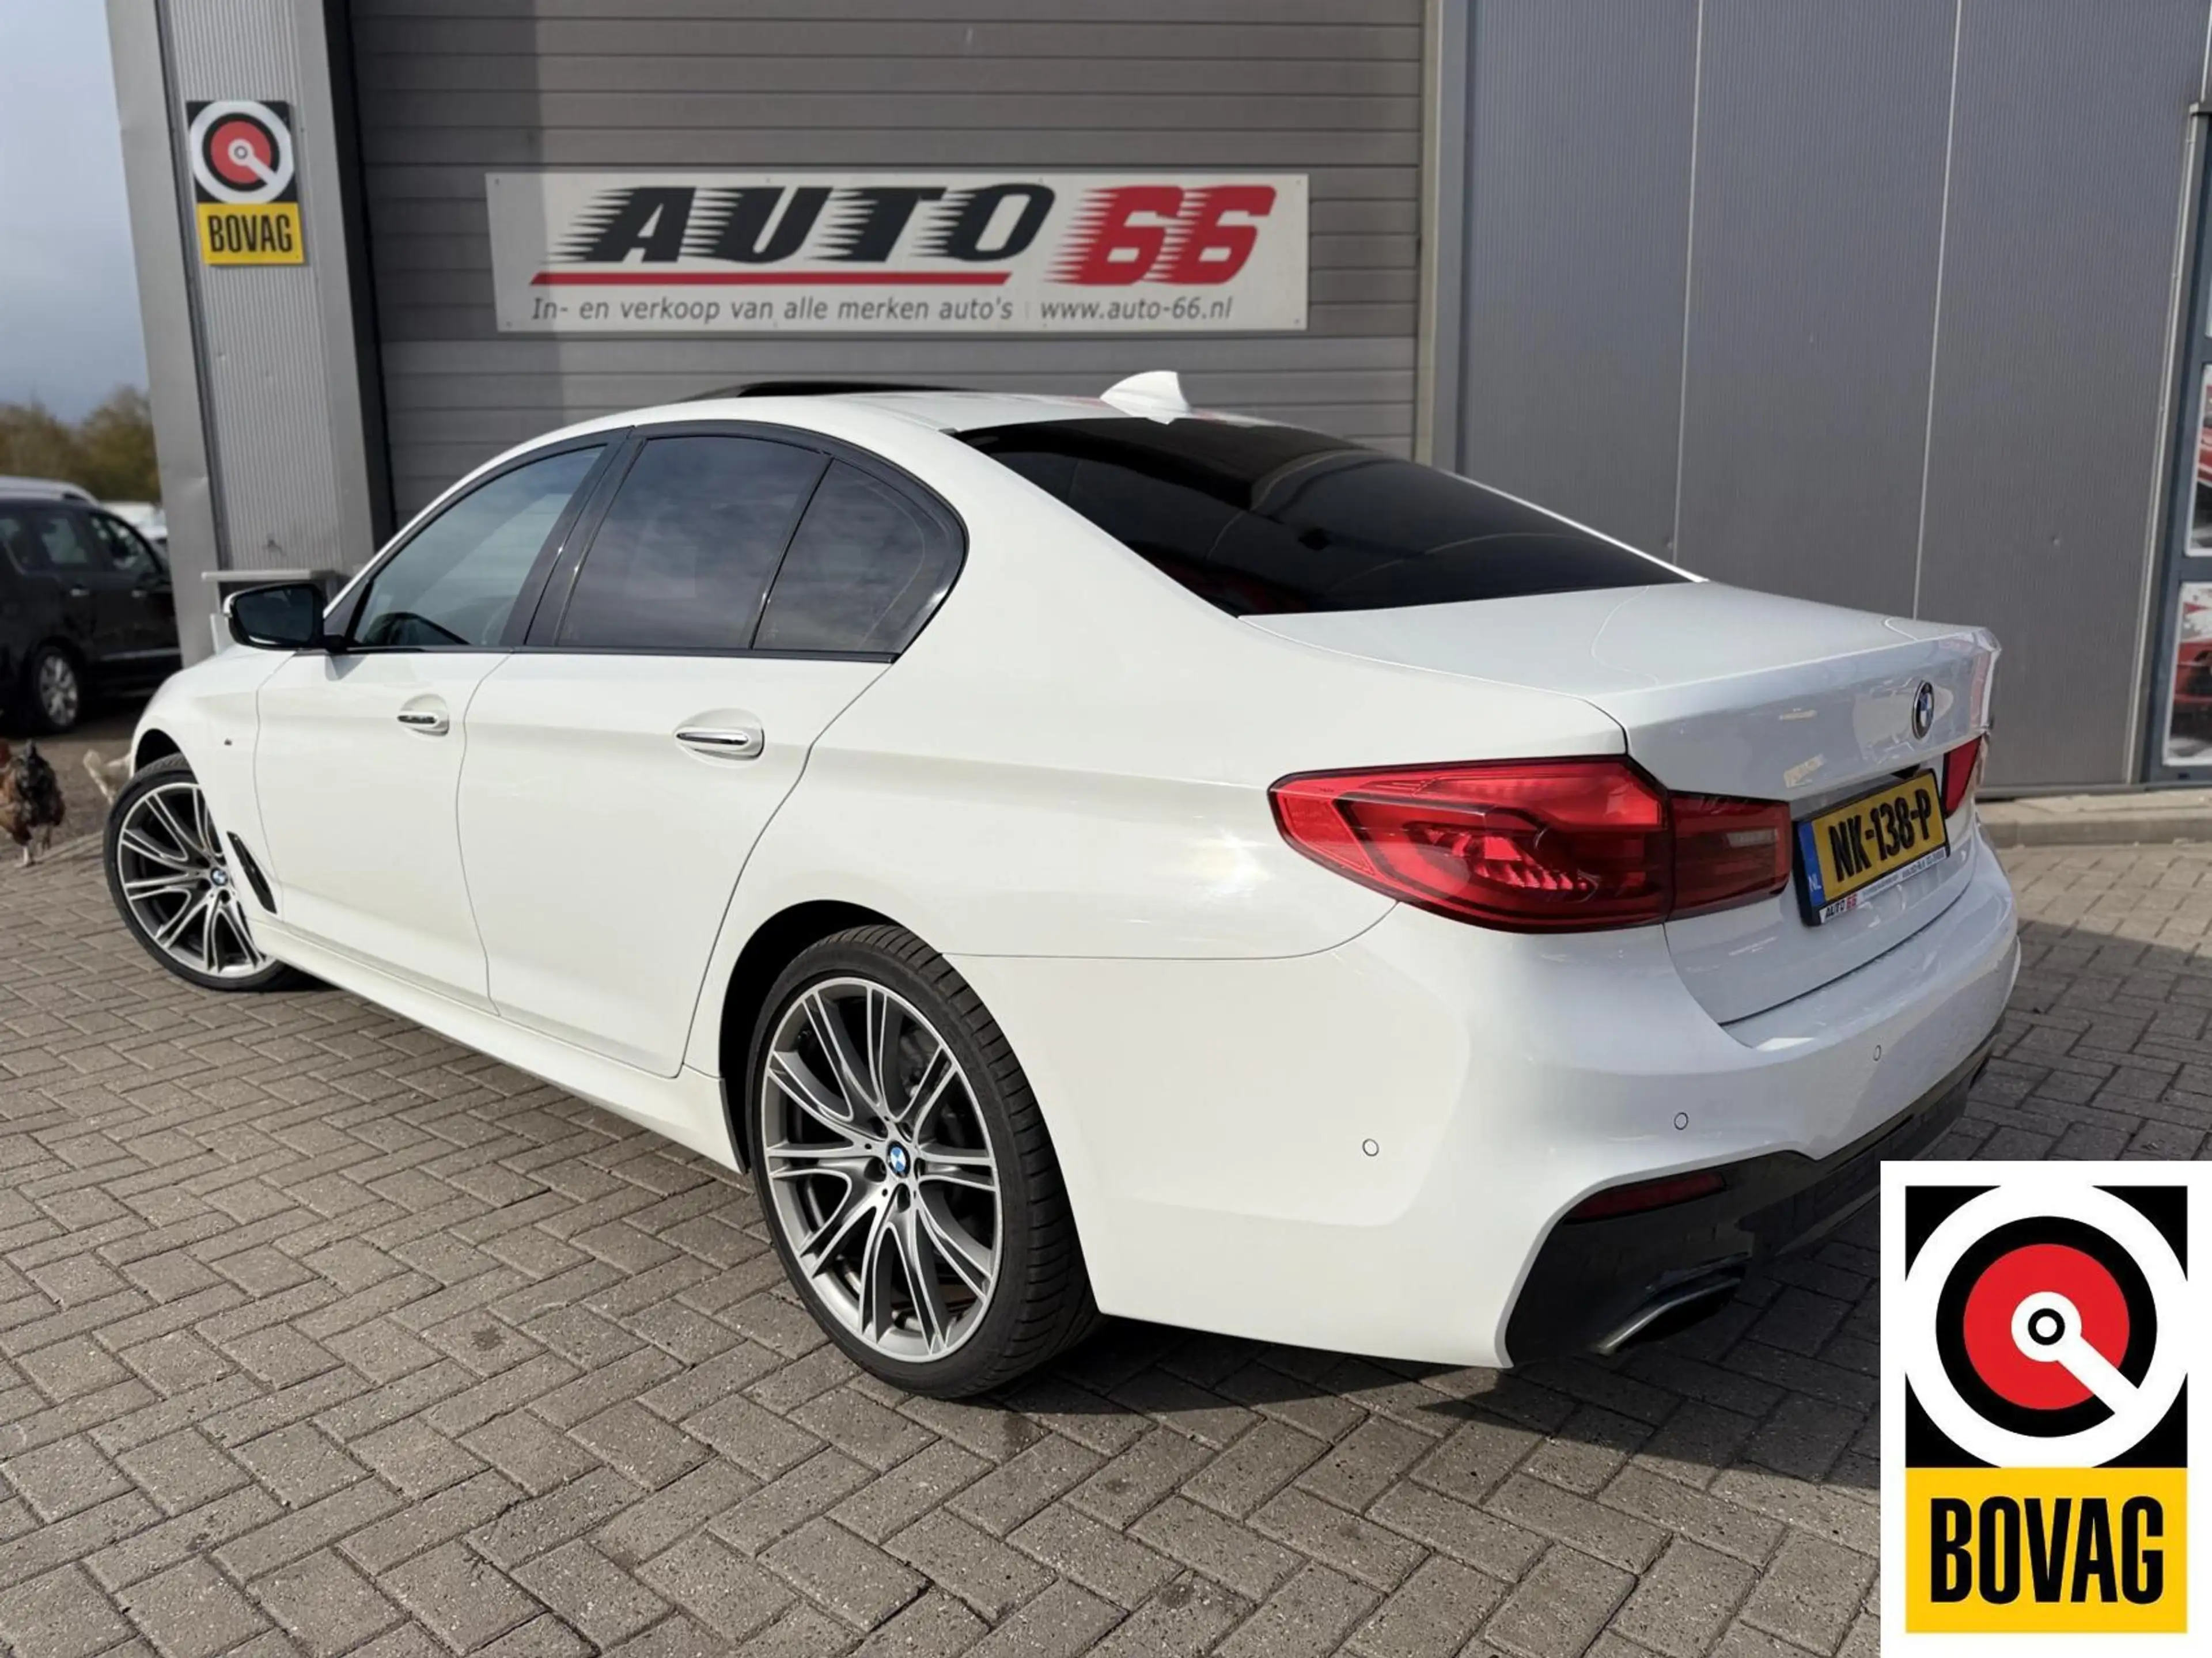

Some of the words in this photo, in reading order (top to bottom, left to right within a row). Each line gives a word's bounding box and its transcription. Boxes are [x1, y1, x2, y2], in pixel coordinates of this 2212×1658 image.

[207, 214, 292, 253] BOVAG
[545, 183, 1055, 264] AUTO
[1044, 184, 1277, 286] 66
[531, 297, 569, 320] In-
[579, 301, 609, 320] en
[620, 296, 720, 324] verkoop
[730, 301, 773, 320] van
[783, 295, 828, 320] alle
[837, 296, 929, 320] merken
[939, 296, 1014, 320] auto's
[1040, 295, 1234, 321] www.auto-66.nl
[1828, 788, 1932, 883] NK-138-P
[1808, 872, 1822, 892] NL
